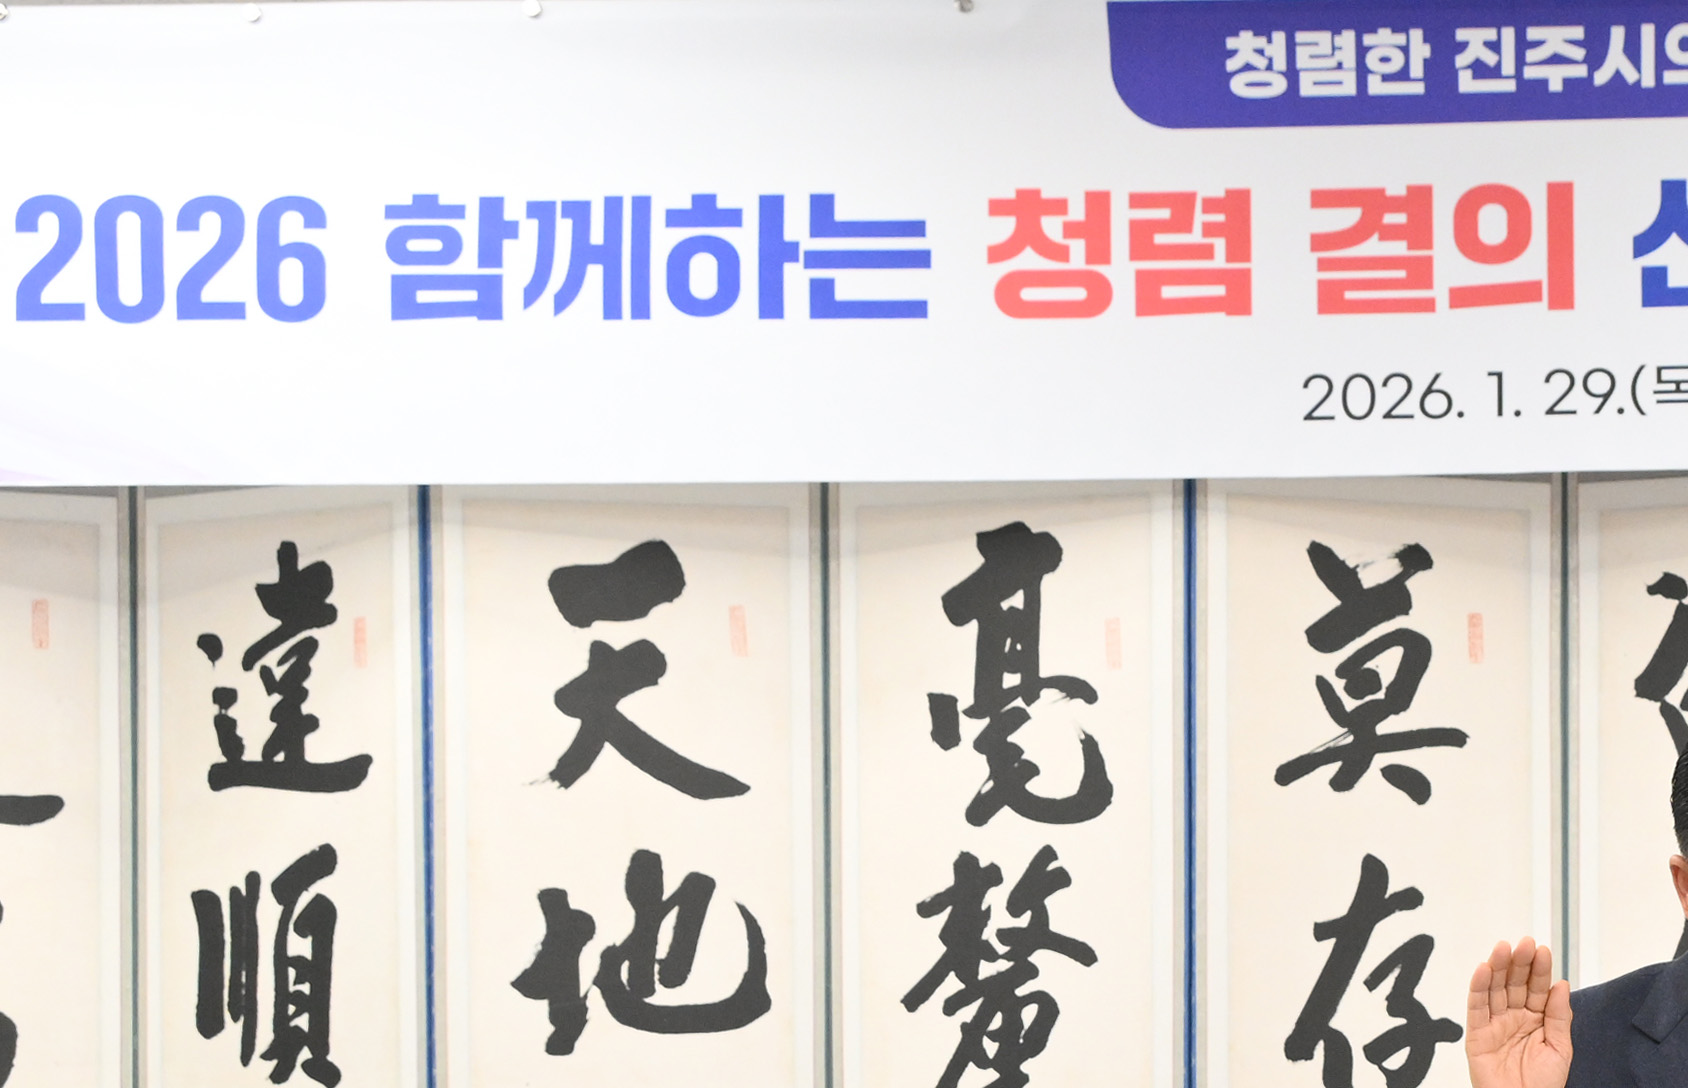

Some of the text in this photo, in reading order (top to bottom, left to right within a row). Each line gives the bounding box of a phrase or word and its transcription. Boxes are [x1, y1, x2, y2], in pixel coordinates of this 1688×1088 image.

[1225, 28, 1431, 97] 청렴한
[15, 194, 327, 324] 2026
[384, 193, 932, 321] 함께하는
[986, 188, 1253, 320] 청렴
[1309, 181, 1576, 315] 결의
[1302, 372, 1464, 421] 2026.
[1487, 371, 1522, 417] 1.
